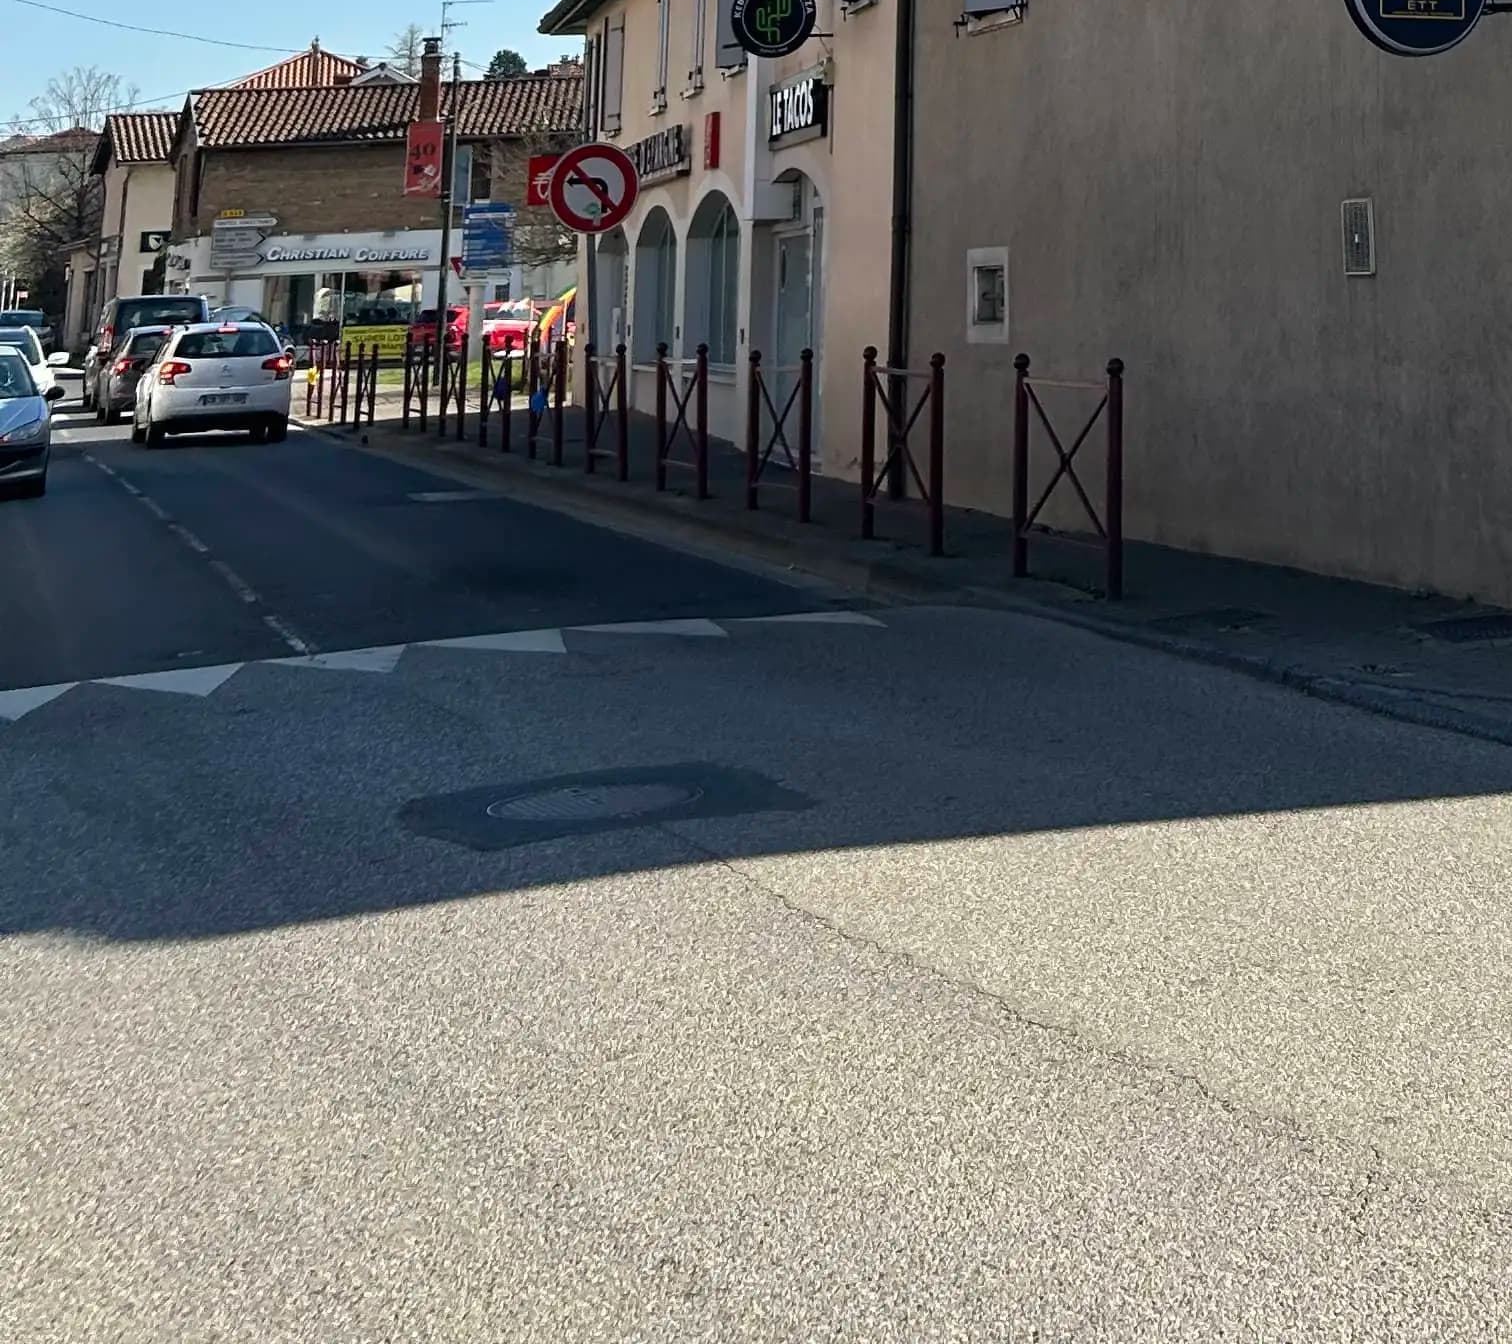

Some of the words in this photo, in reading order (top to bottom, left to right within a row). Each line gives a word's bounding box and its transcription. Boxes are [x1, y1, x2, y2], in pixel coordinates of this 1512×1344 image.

[1407, 0, 1439, 11] ETT
[772, 91, 782, 136] LE
[783, 78, 814, 132] TACOS
[266, 246, 350, 262] CHRISTIAN
